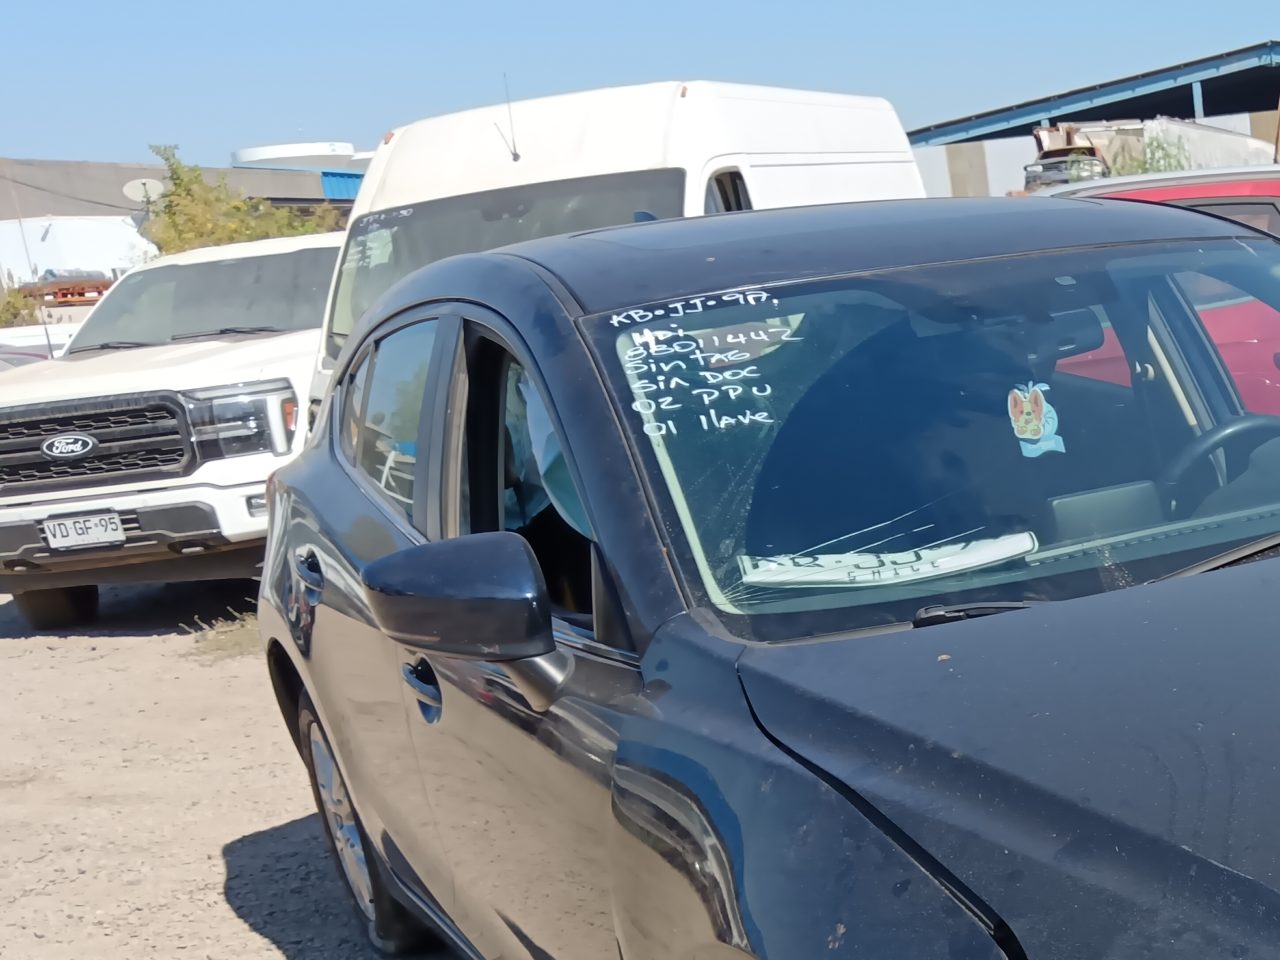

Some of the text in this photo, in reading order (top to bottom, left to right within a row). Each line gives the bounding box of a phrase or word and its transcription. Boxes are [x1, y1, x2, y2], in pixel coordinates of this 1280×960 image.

[699, 366, 761, 384] DOC
[632, 384, 772, 414] 02 PPU
[643, 420, 678, 436] 01
[52, 438, 83, 454] Ford
